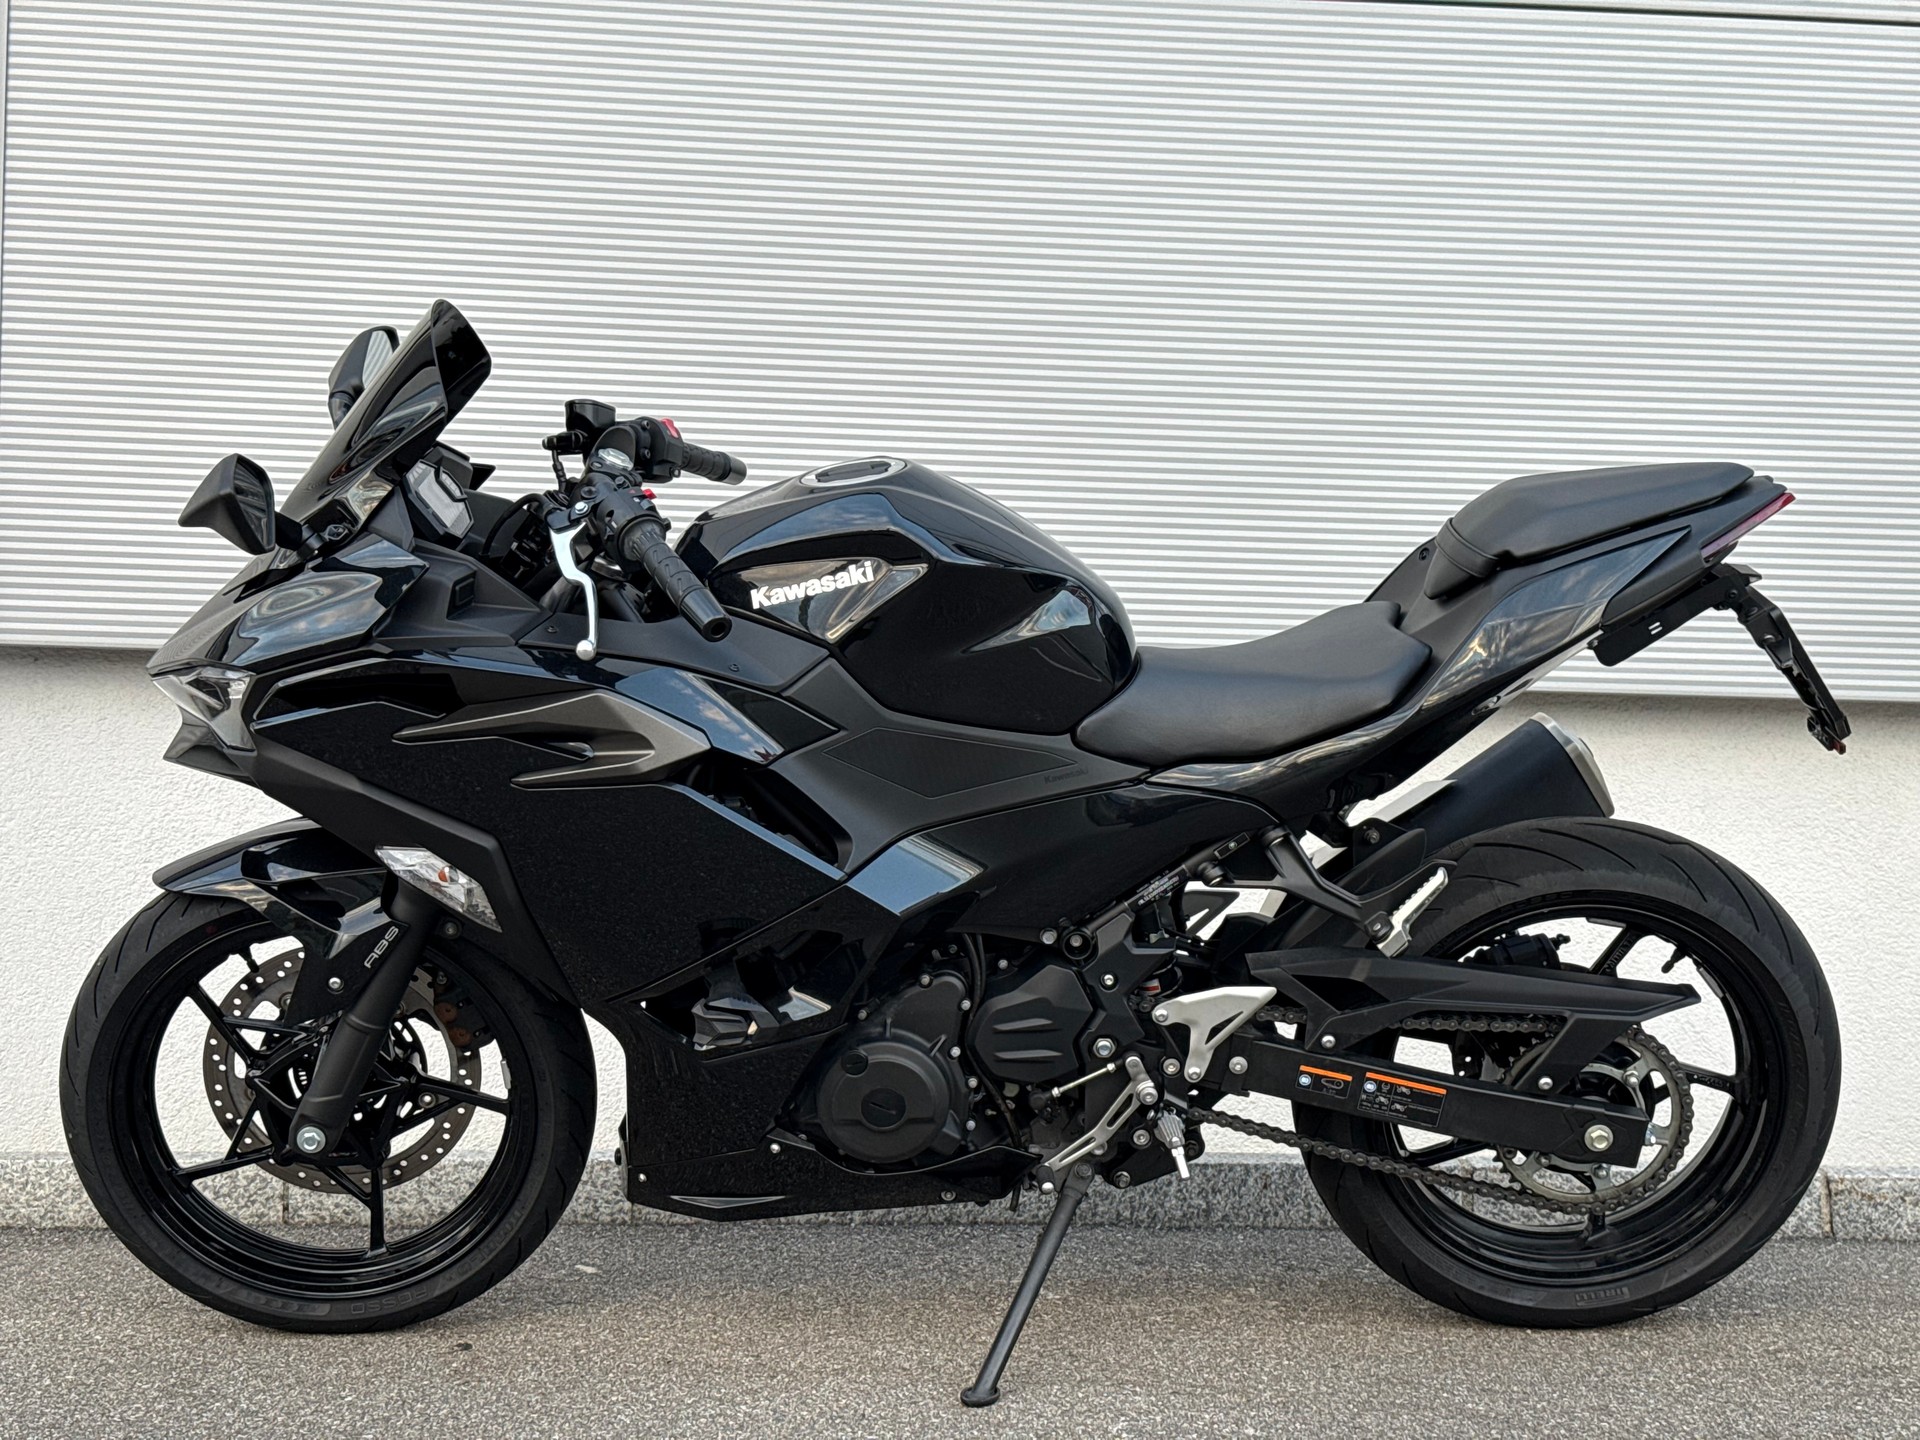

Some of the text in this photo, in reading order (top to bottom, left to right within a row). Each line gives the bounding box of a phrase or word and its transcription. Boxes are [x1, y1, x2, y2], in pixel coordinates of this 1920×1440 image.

[750, 560, 875, 610] Kawasaki
[363, 925, 400, 970] ABS
[350, 1284, 429, 1315] ROSSO
[1575, 1285, 1630, 1308] PIRELLI
